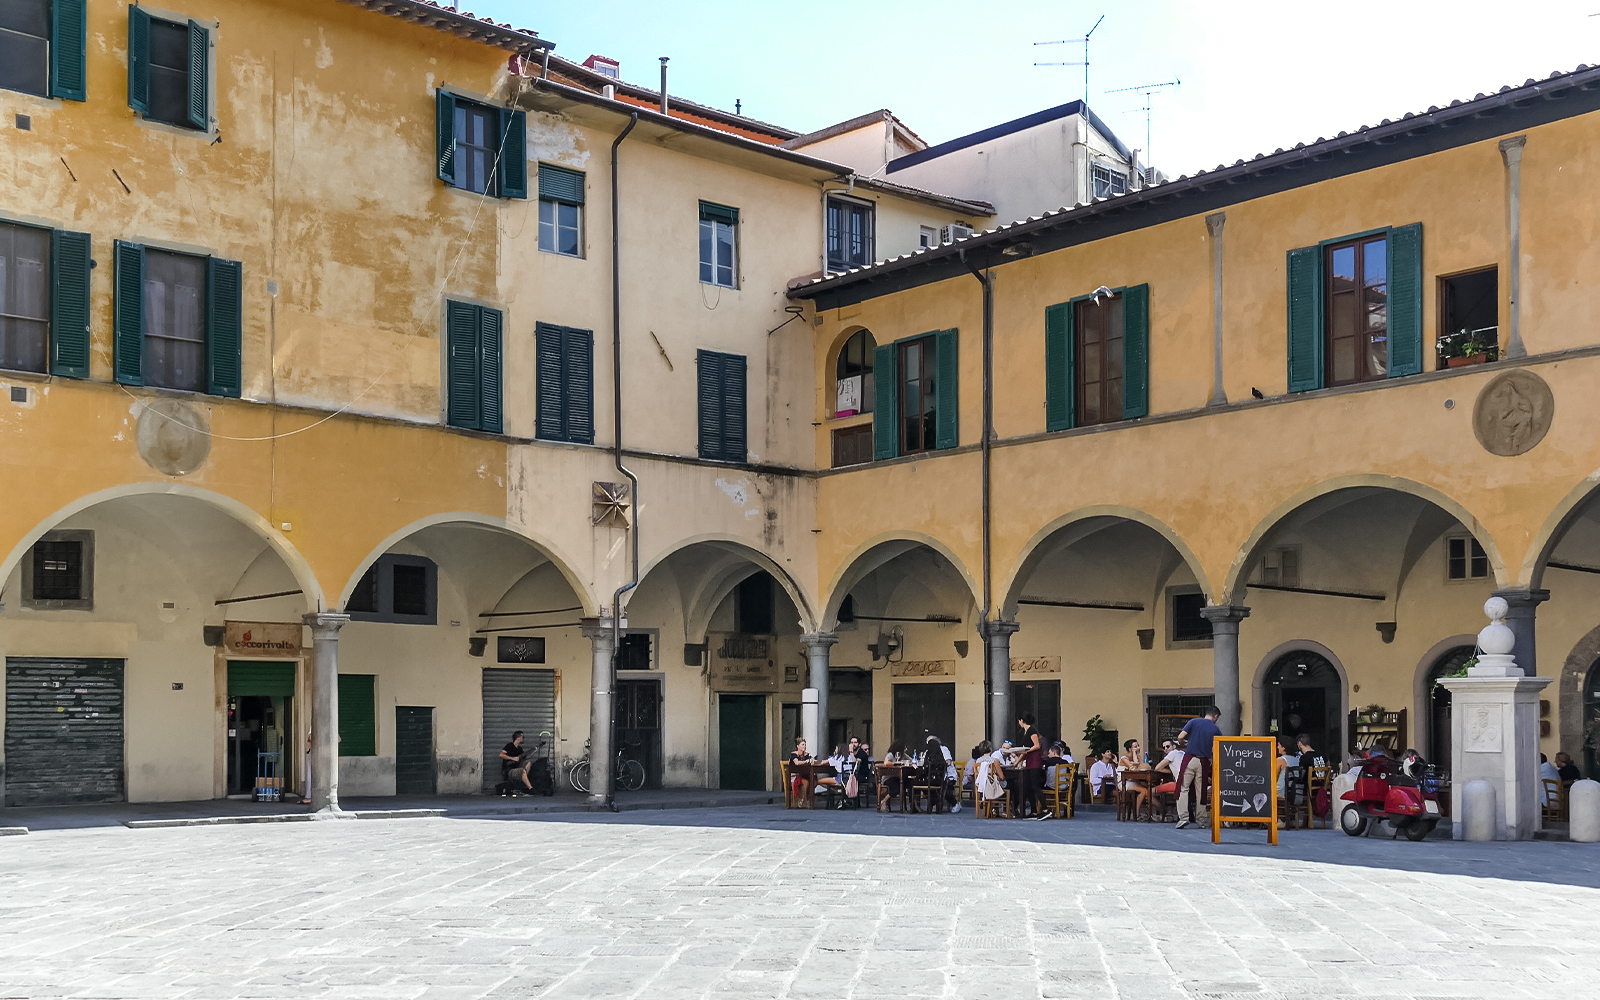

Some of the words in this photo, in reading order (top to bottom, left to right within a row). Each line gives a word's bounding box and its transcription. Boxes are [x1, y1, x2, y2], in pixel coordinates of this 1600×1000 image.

[1223, 744, 1263, 759] Vineria
[1235, 758, 1246, 768] di
[1222, 768, 1265, 785] Piazza
